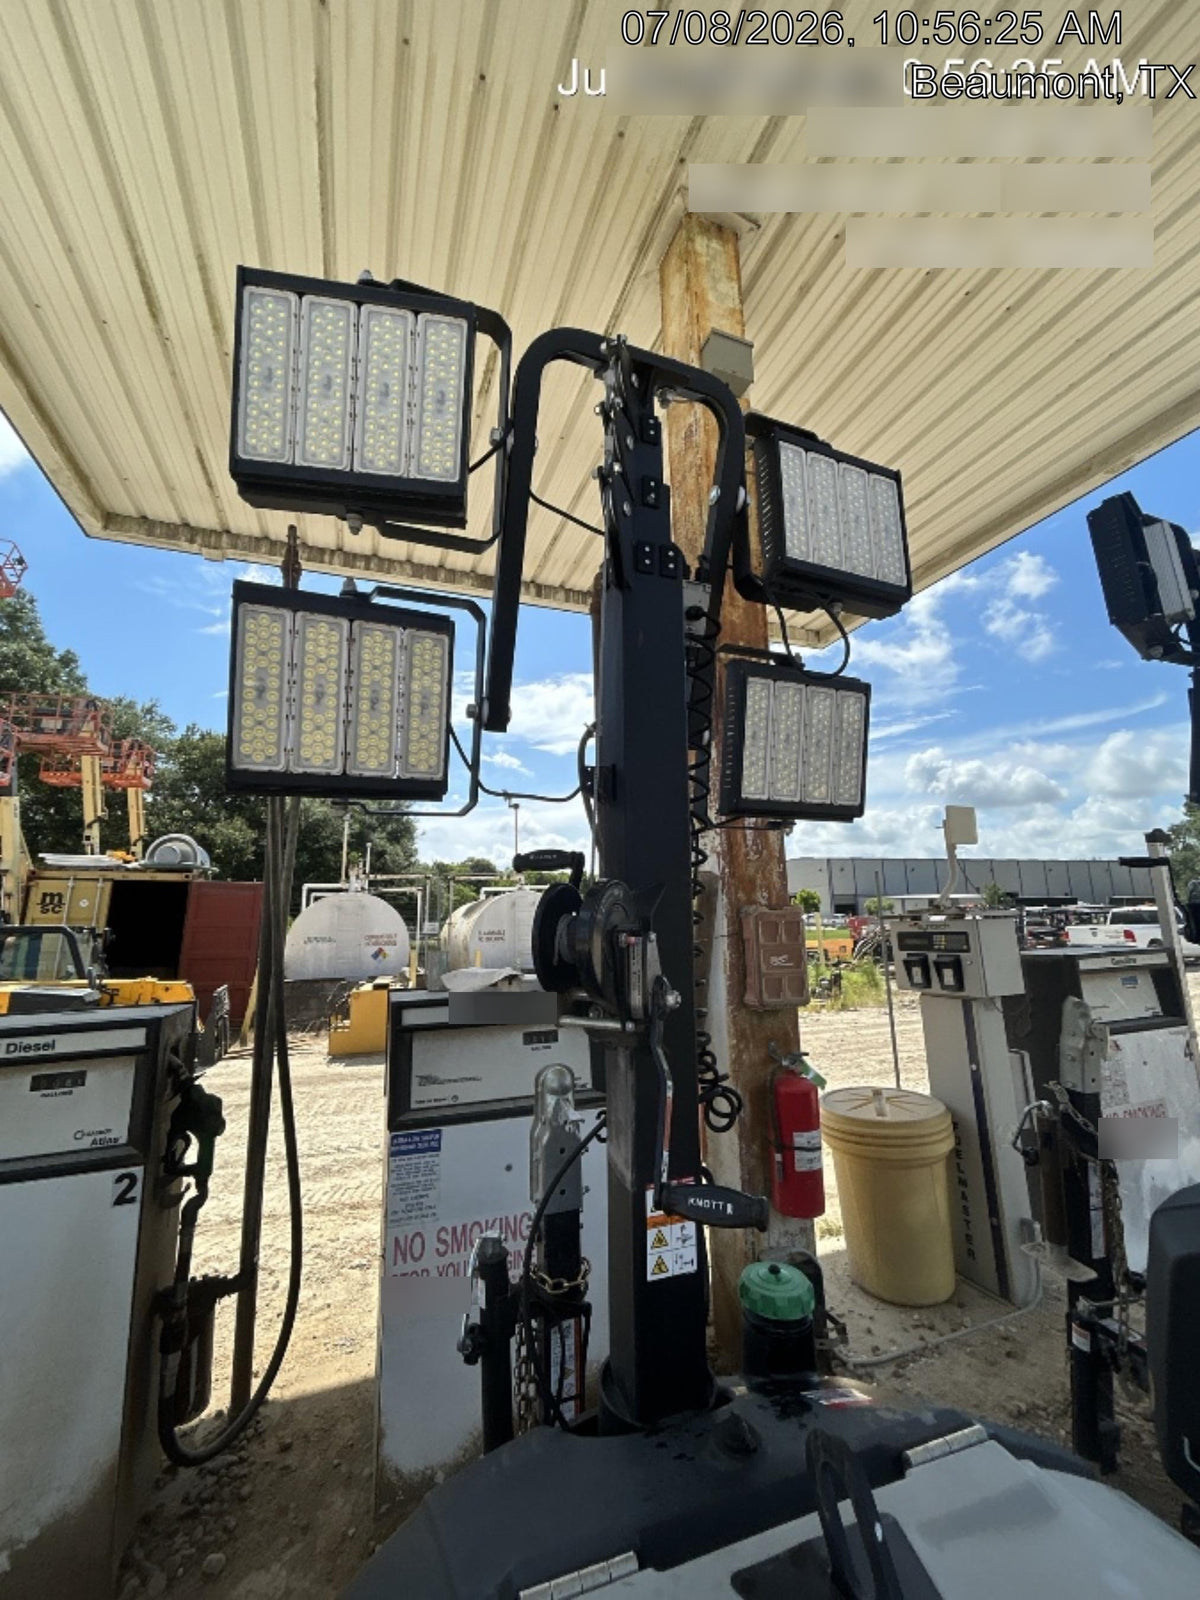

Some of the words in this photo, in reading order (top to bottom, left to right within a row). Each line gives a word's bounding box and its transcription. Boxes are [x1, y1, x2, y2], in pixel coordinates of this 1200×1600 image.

[6, 1039, 56, 1055] Diesel
[112, 1172, 139, 1208] 2
[687, 1197, 724, 1211] KNOTT
[393, 1231, 426, 1267] NO
[434, 1211, 533, 1258] SMOKING
